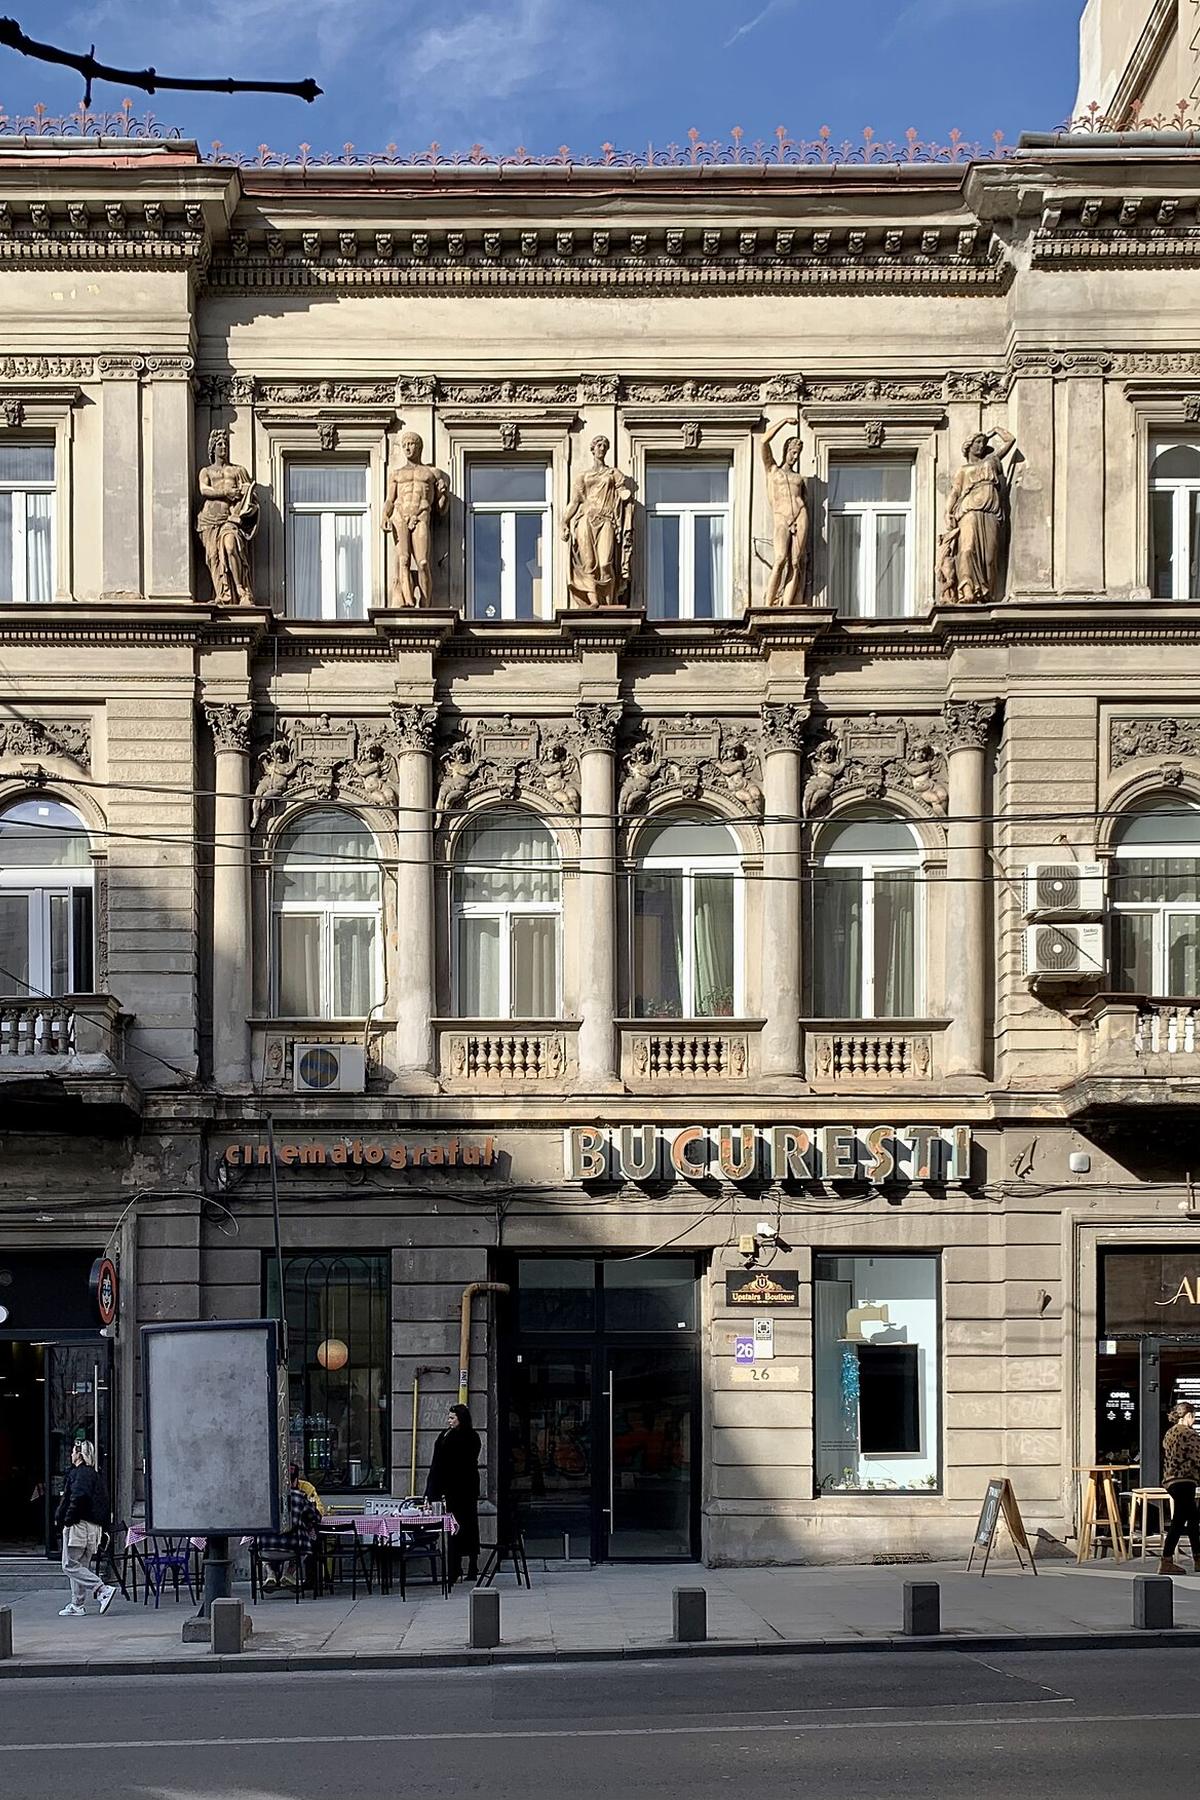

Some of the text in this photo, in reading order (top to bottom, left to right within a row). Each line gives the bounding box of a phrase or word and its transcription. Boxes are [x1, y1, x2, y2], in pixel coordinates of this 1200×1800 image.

[225, 1136, 494, 1170] cinematograful
[732, 1292, 795, 1302] Upstairs Boutique
[737, 1343, 754, 1358] 26
[750, 1368, 770, 1381] 26
